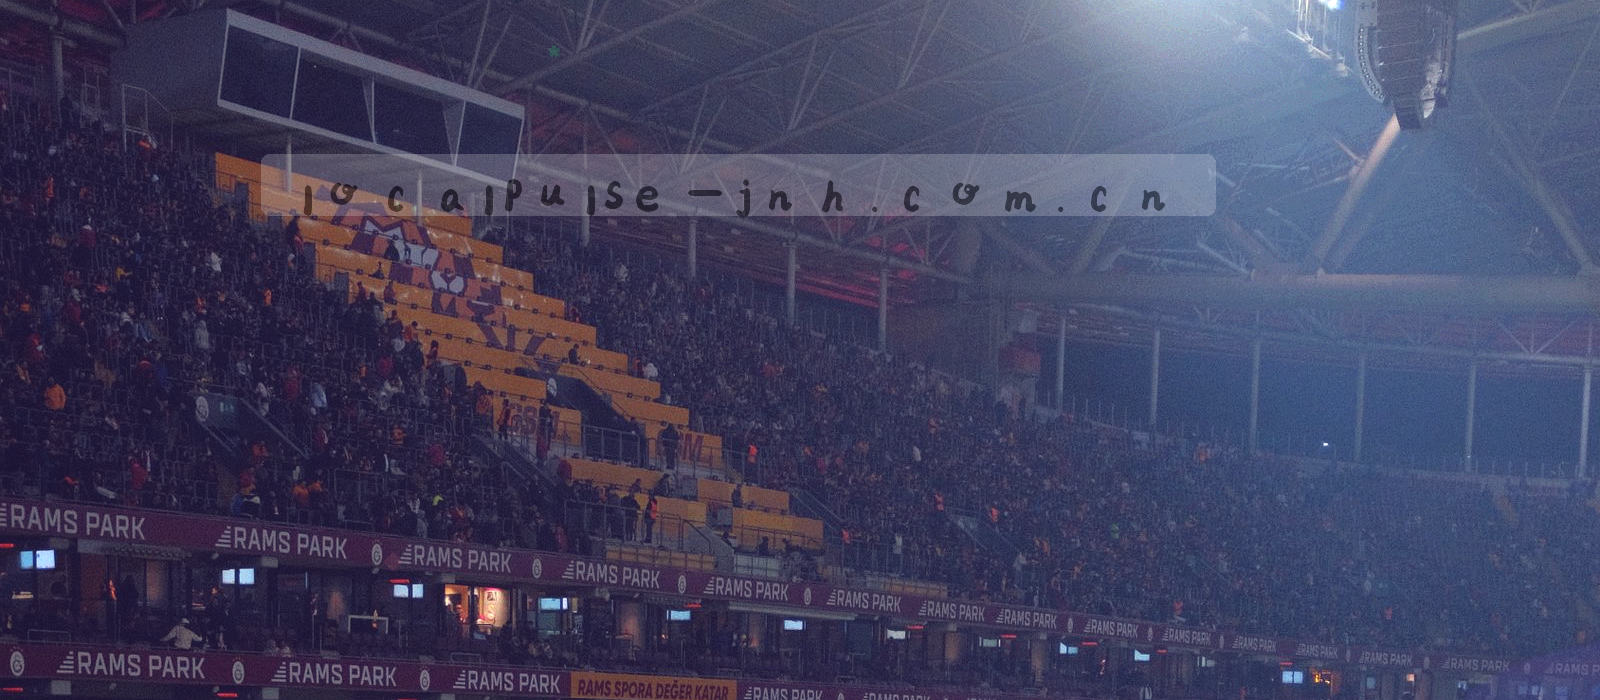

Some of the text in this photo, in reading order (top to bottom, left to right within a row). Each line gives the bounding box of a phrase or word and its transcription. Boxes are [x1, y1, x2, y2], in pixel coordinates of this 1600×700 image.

[10, 503, 146, 540] RAMS PARK
[233, 526, 347, 560] RAMS PARK
[414, 544, 512, 573] RAMS PARK
[576, 561, 660, 589] RAMS PARK
[715, 577, 789, 601] RAMS PARK
[837, 589, 901, 613] RAMS PARK
[927, 600, 985, 622] RAMS PARK
[1004, 609, 1057, 629] RAMS PARK
[1091, 619, 1138, 639] RAMS PARK
[1168, 628, 1212, 647] RAMS PARK
[77, 650, 205, 679] RAMS PARK
[289, 662, 397, 687] RAMS PARK
[1451, 657, 1479, 671] RAMS
[468, 670, 560, 694] RAMS PARK
[577, 679, 729, 700] RAMS SPORA DEĞER KATAR
